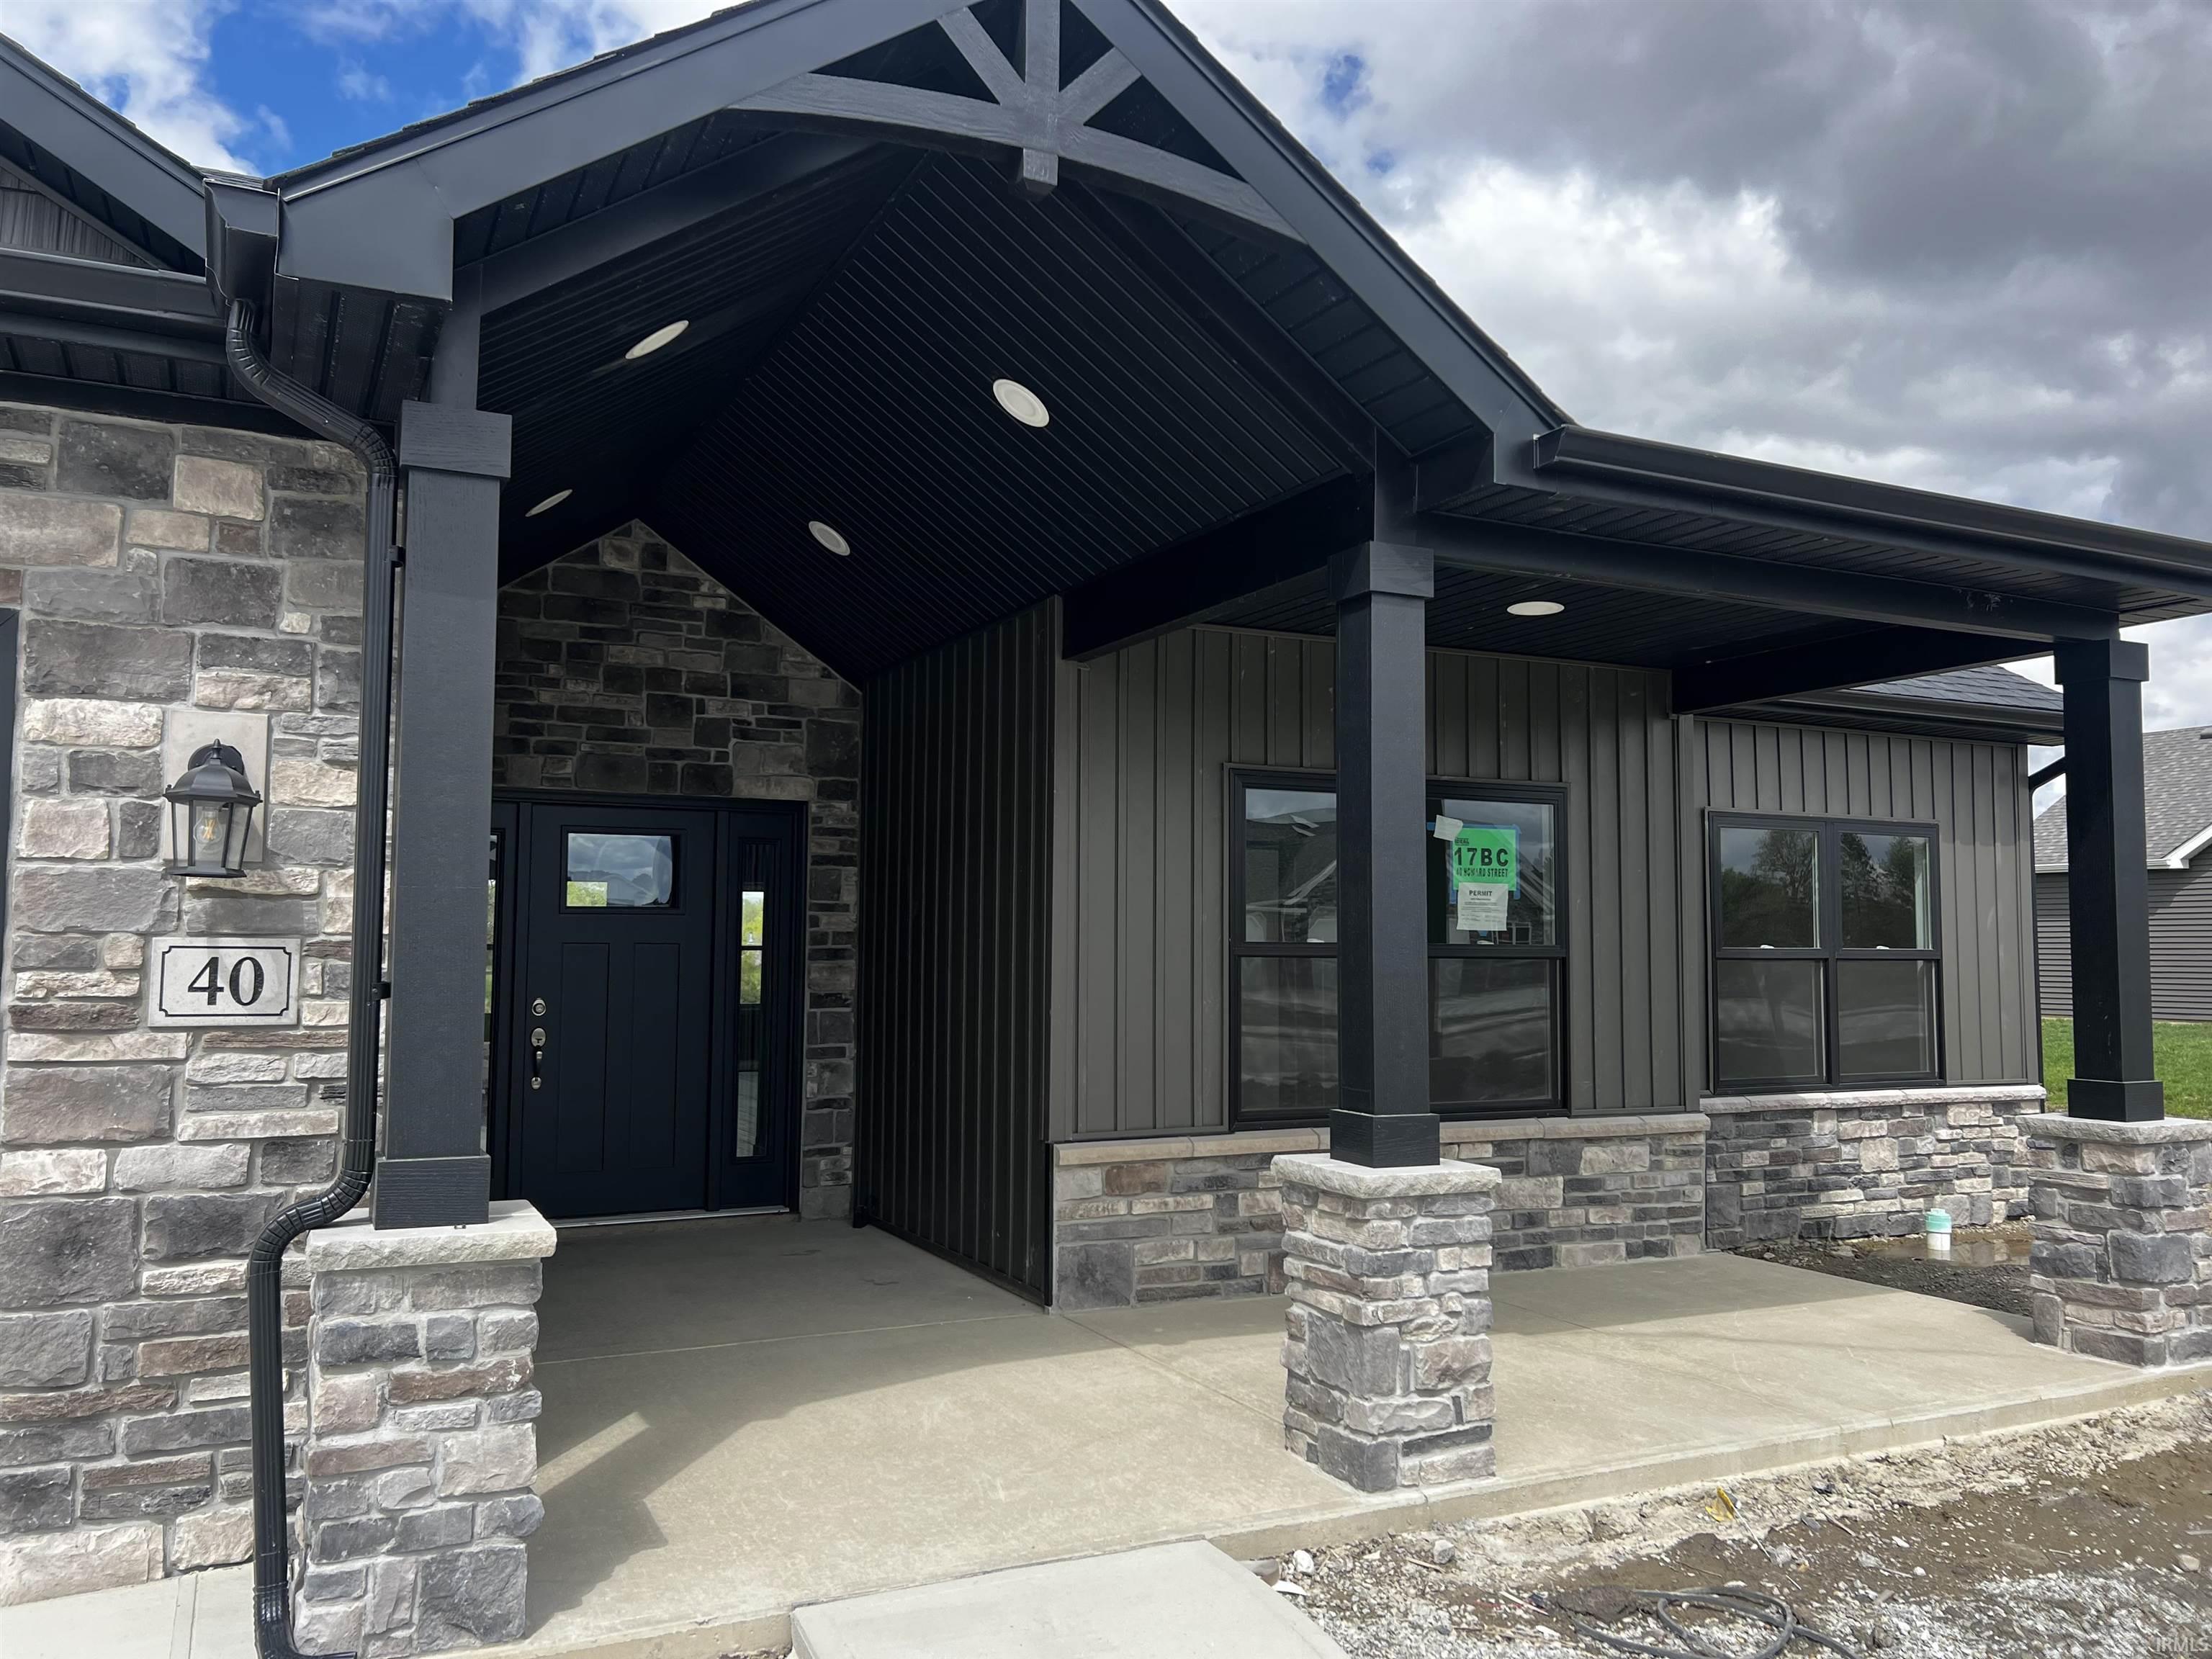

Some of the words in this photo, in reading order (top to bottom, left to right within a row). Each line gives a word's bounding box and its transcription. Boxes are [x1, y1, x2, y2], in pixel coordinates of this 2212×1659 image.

[1455, 847, 1509, 867] 17BC
[1487, 868, 1508, 877] STREET
[187, 956, 265, 1006] 40
